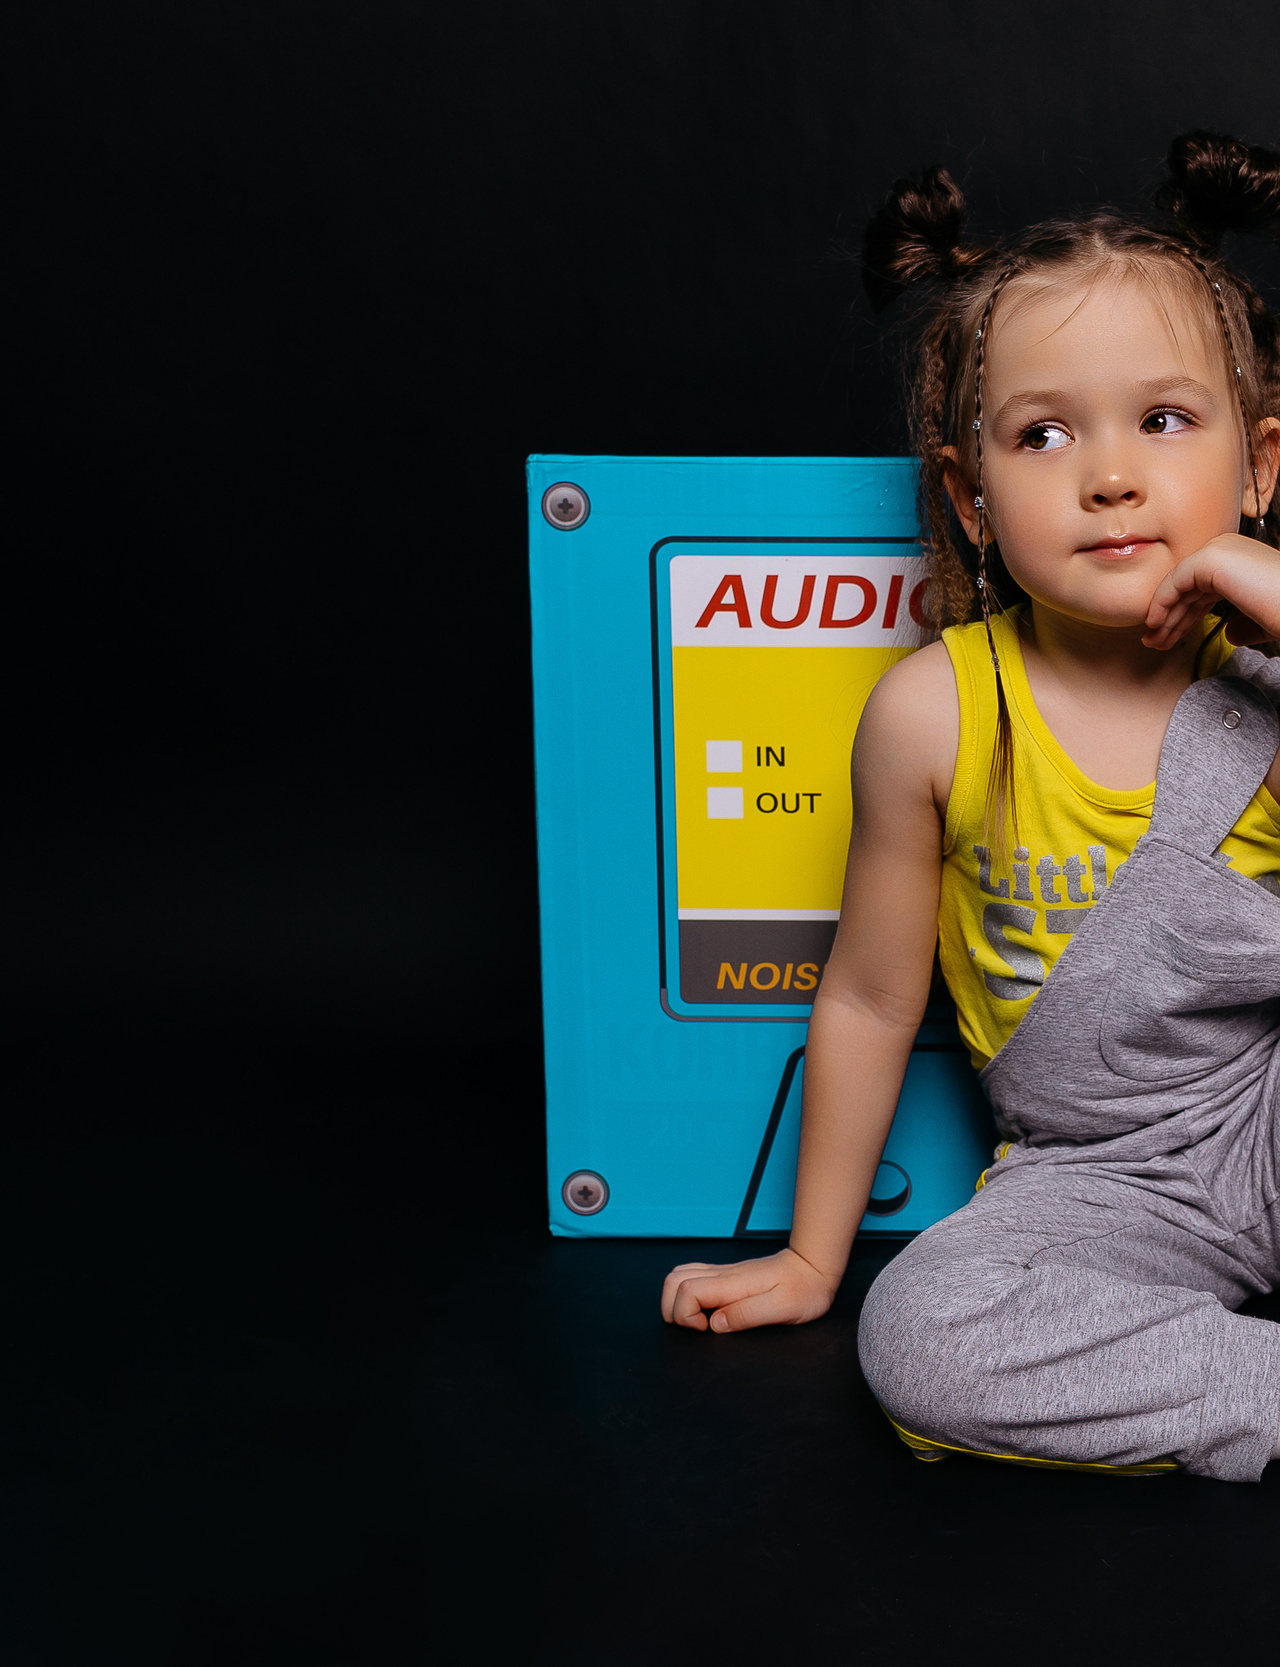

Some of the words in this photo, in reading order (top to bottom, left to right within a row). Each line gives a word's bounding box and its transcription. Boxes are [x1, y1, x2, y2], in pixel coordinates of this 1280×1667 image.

[756, 746, 786, 768] IN
[756, 792, 823, 814] OUT
[972, 844, 1125, 903] Littl
[716, 962, 828, 991] NOIS
